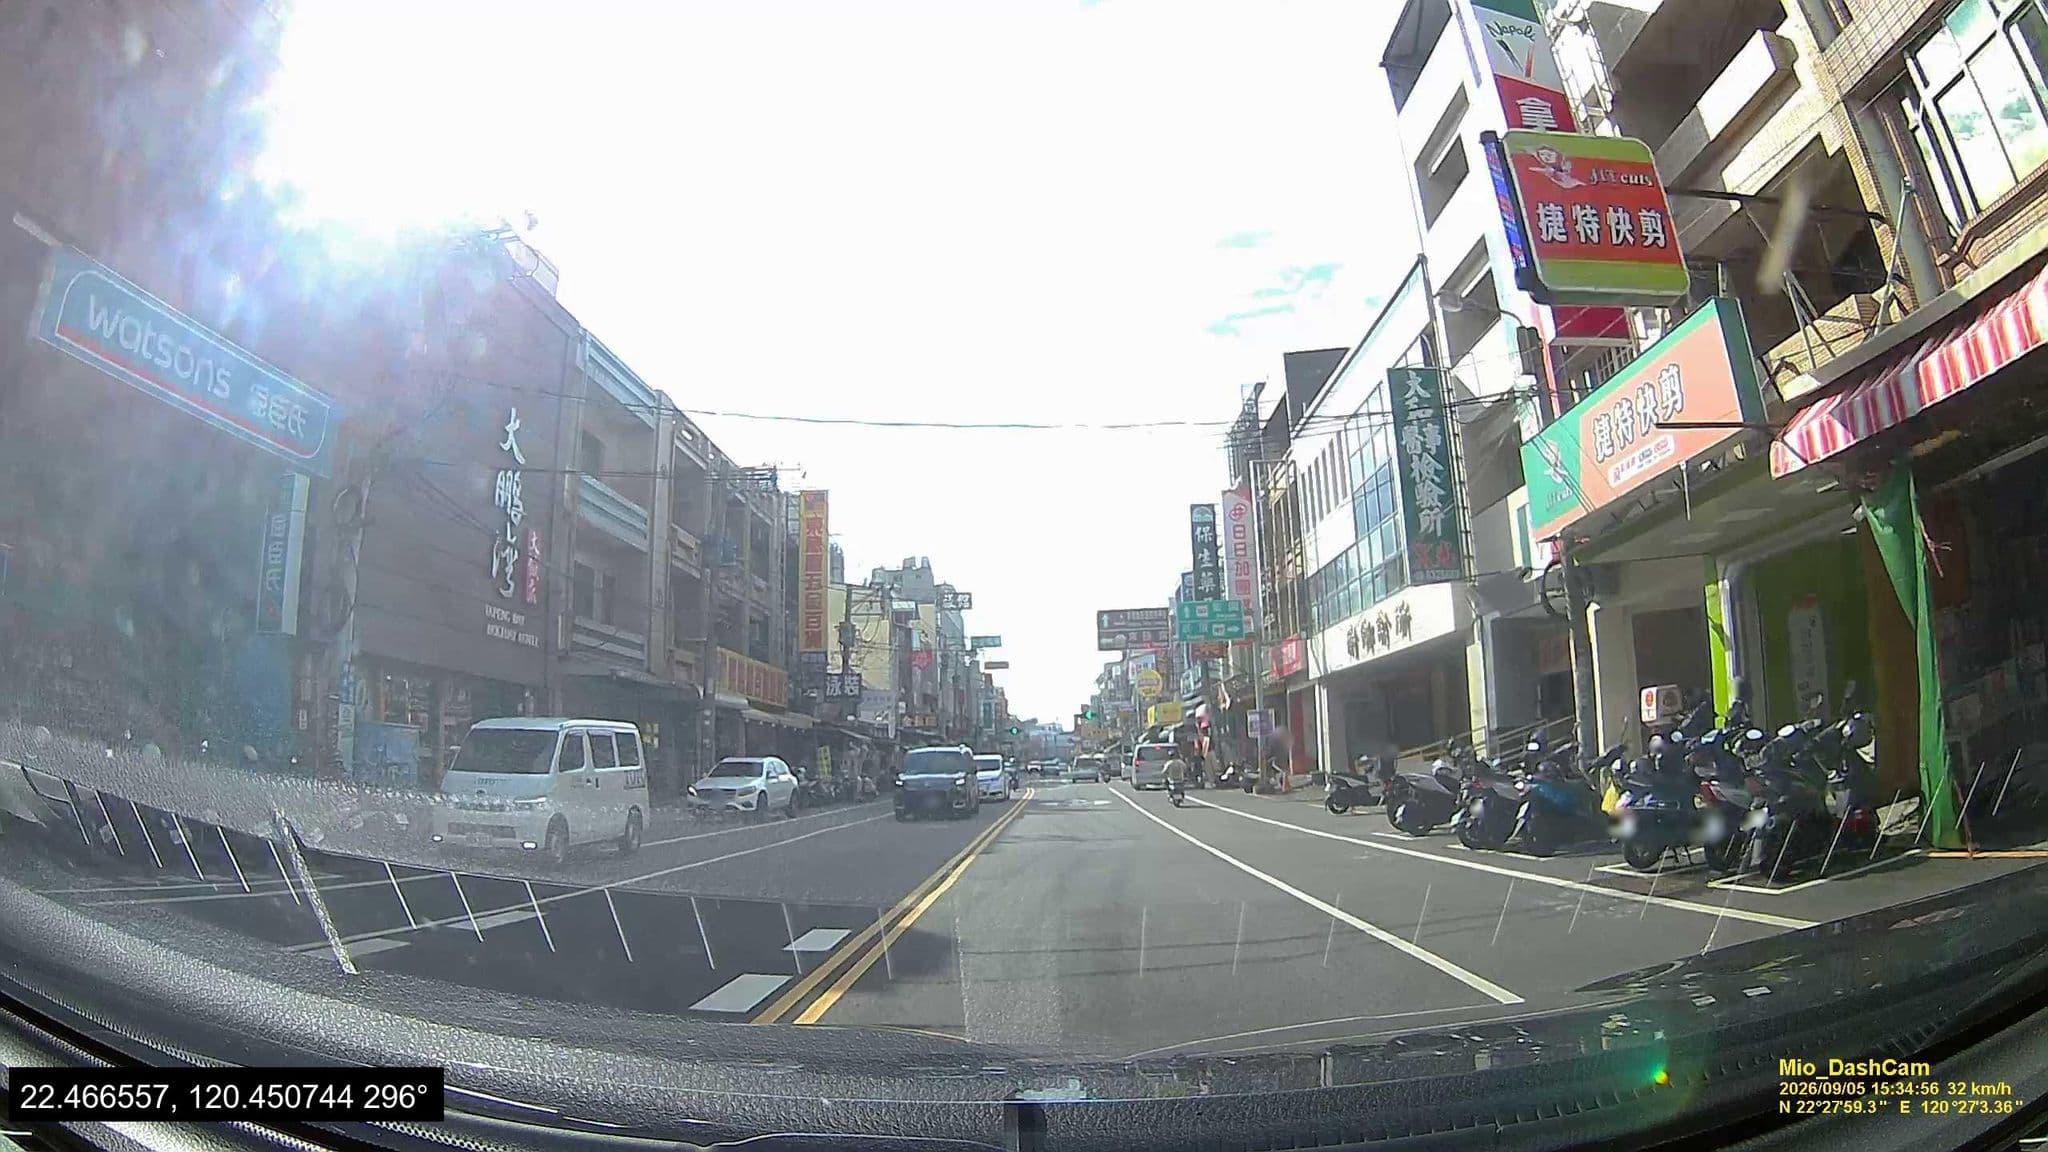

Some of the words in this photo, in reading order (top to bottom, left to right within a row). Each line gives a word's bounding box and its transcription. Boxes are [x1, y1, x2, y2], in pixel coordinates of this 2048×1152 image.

[1536, 202, 1667, 247] 捷特快剪
[88, 294, 232, 399] watsons
[1592, 363, 1684, 463] 捷特快剪
[491, 407, 527, 598] 大鵬灣
[1195, 526, 1216, 601] 保生藥
[825, 674, 860, 696] 泳裝
